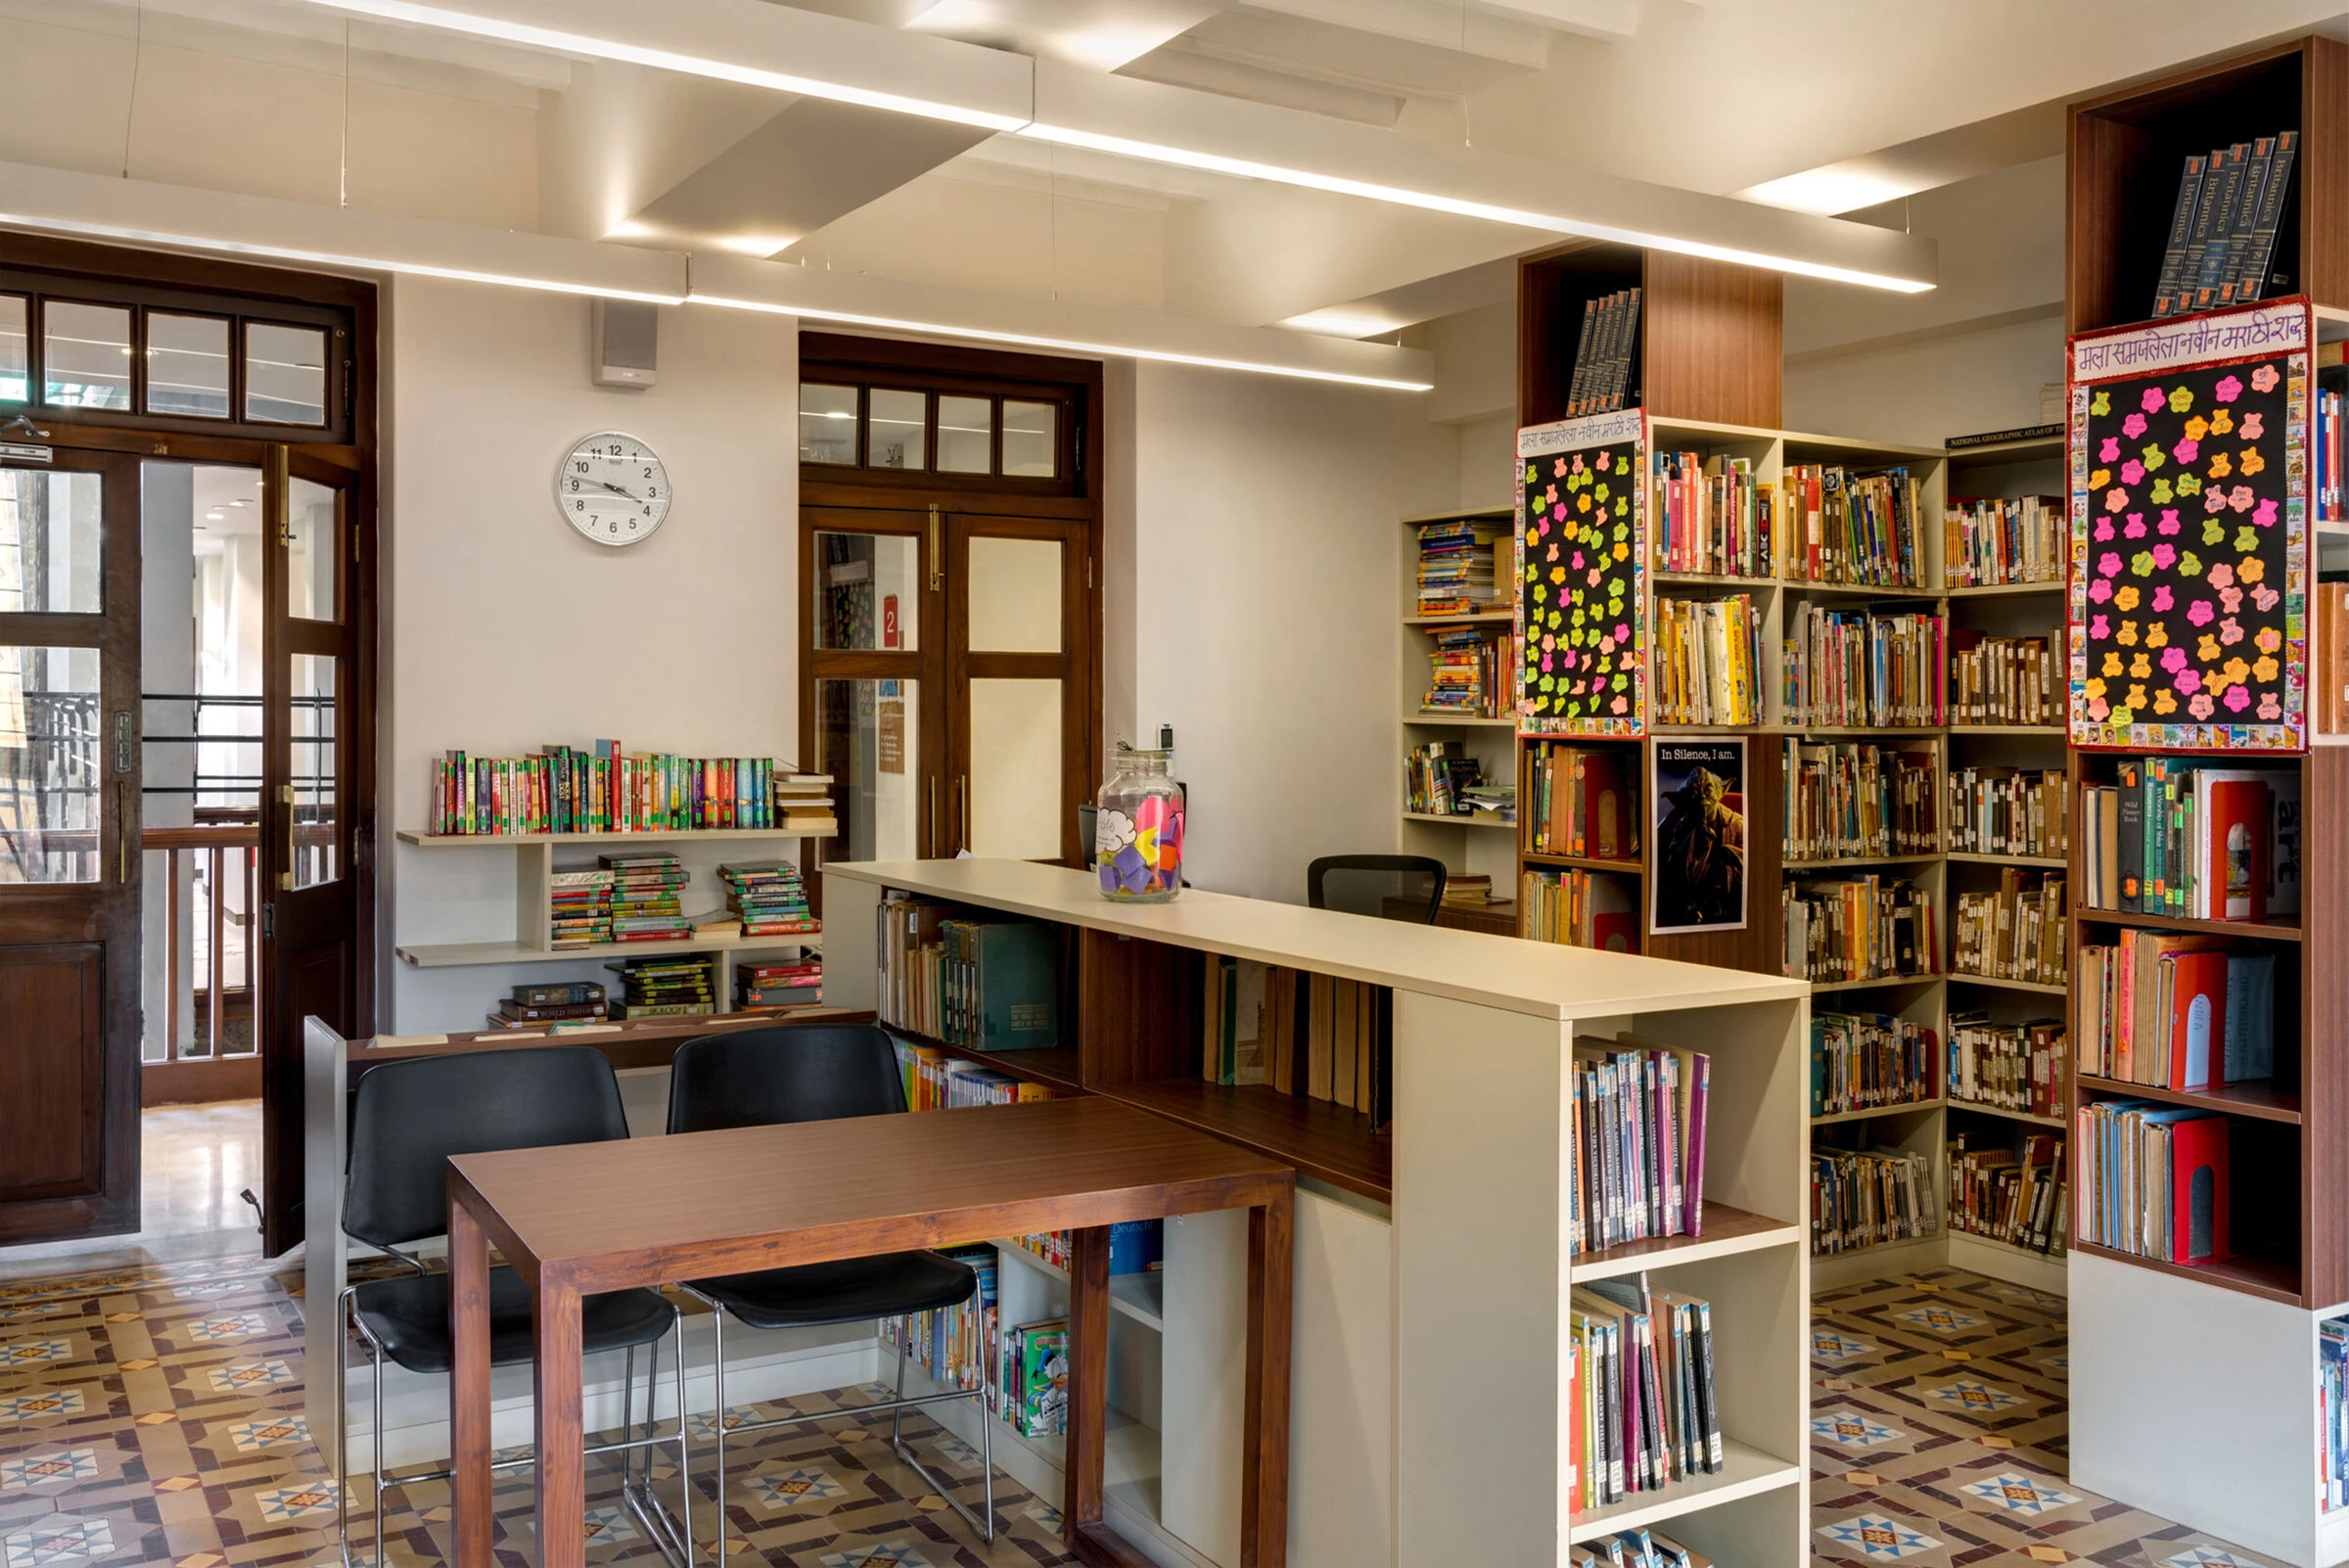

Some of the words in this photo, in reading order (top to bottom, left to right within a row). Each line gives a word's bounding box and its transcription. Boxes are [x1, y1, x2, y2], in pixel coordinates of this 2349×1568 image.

[2239, 165, 2262, 226] Britannica
[2263, 160, 2286, 222] Britannica
[2217, 171, 2239, 232] Britannica
[2174, 183, 2195, 243] Britannica
[2197, 178, 2219, 238] Britannica
[2230, 255, 2239, 264] 28
[2079, 344, 2109, 371] मला
[2223, 311, 2271, 349] मराठी
[1951, 438, 1981, 446] NATIONAL
[1982, 431, 2023, 441] GEOGRAPHIC
[2024, 428, 2044, 437] ATLAS
[609, 444, 622, 456] 12
[576, 461, 588, 473] 10
[643, 467, 652, 479] 2
[572, 480, 579, 491] 9
[648, 486, 656, 498] 3
[576, 500, 584, 511] 8
[643, 505, 651, 517] 4
[590, 515, 598, 527] 7
[609, 522, 618, 532] 6
[629, 519, 636, 530] 5
[887, 611, 895, 633] 2
[1661, 749, 1672, 760] In
[1674, 748, 1711, 761] Silence,
[1713, 749, 1717, 760] I
[1718, 751, 1735, 760] am.
[2155, 795, 2164, 820] Worship
[2278, 801, 2298, 883] art
[539, 1009, 566, 1018] WORLD
[649, 1005, 682, 1015] BIOLOGY
[1112, 1220, 1153, 1233] Deutsch!
